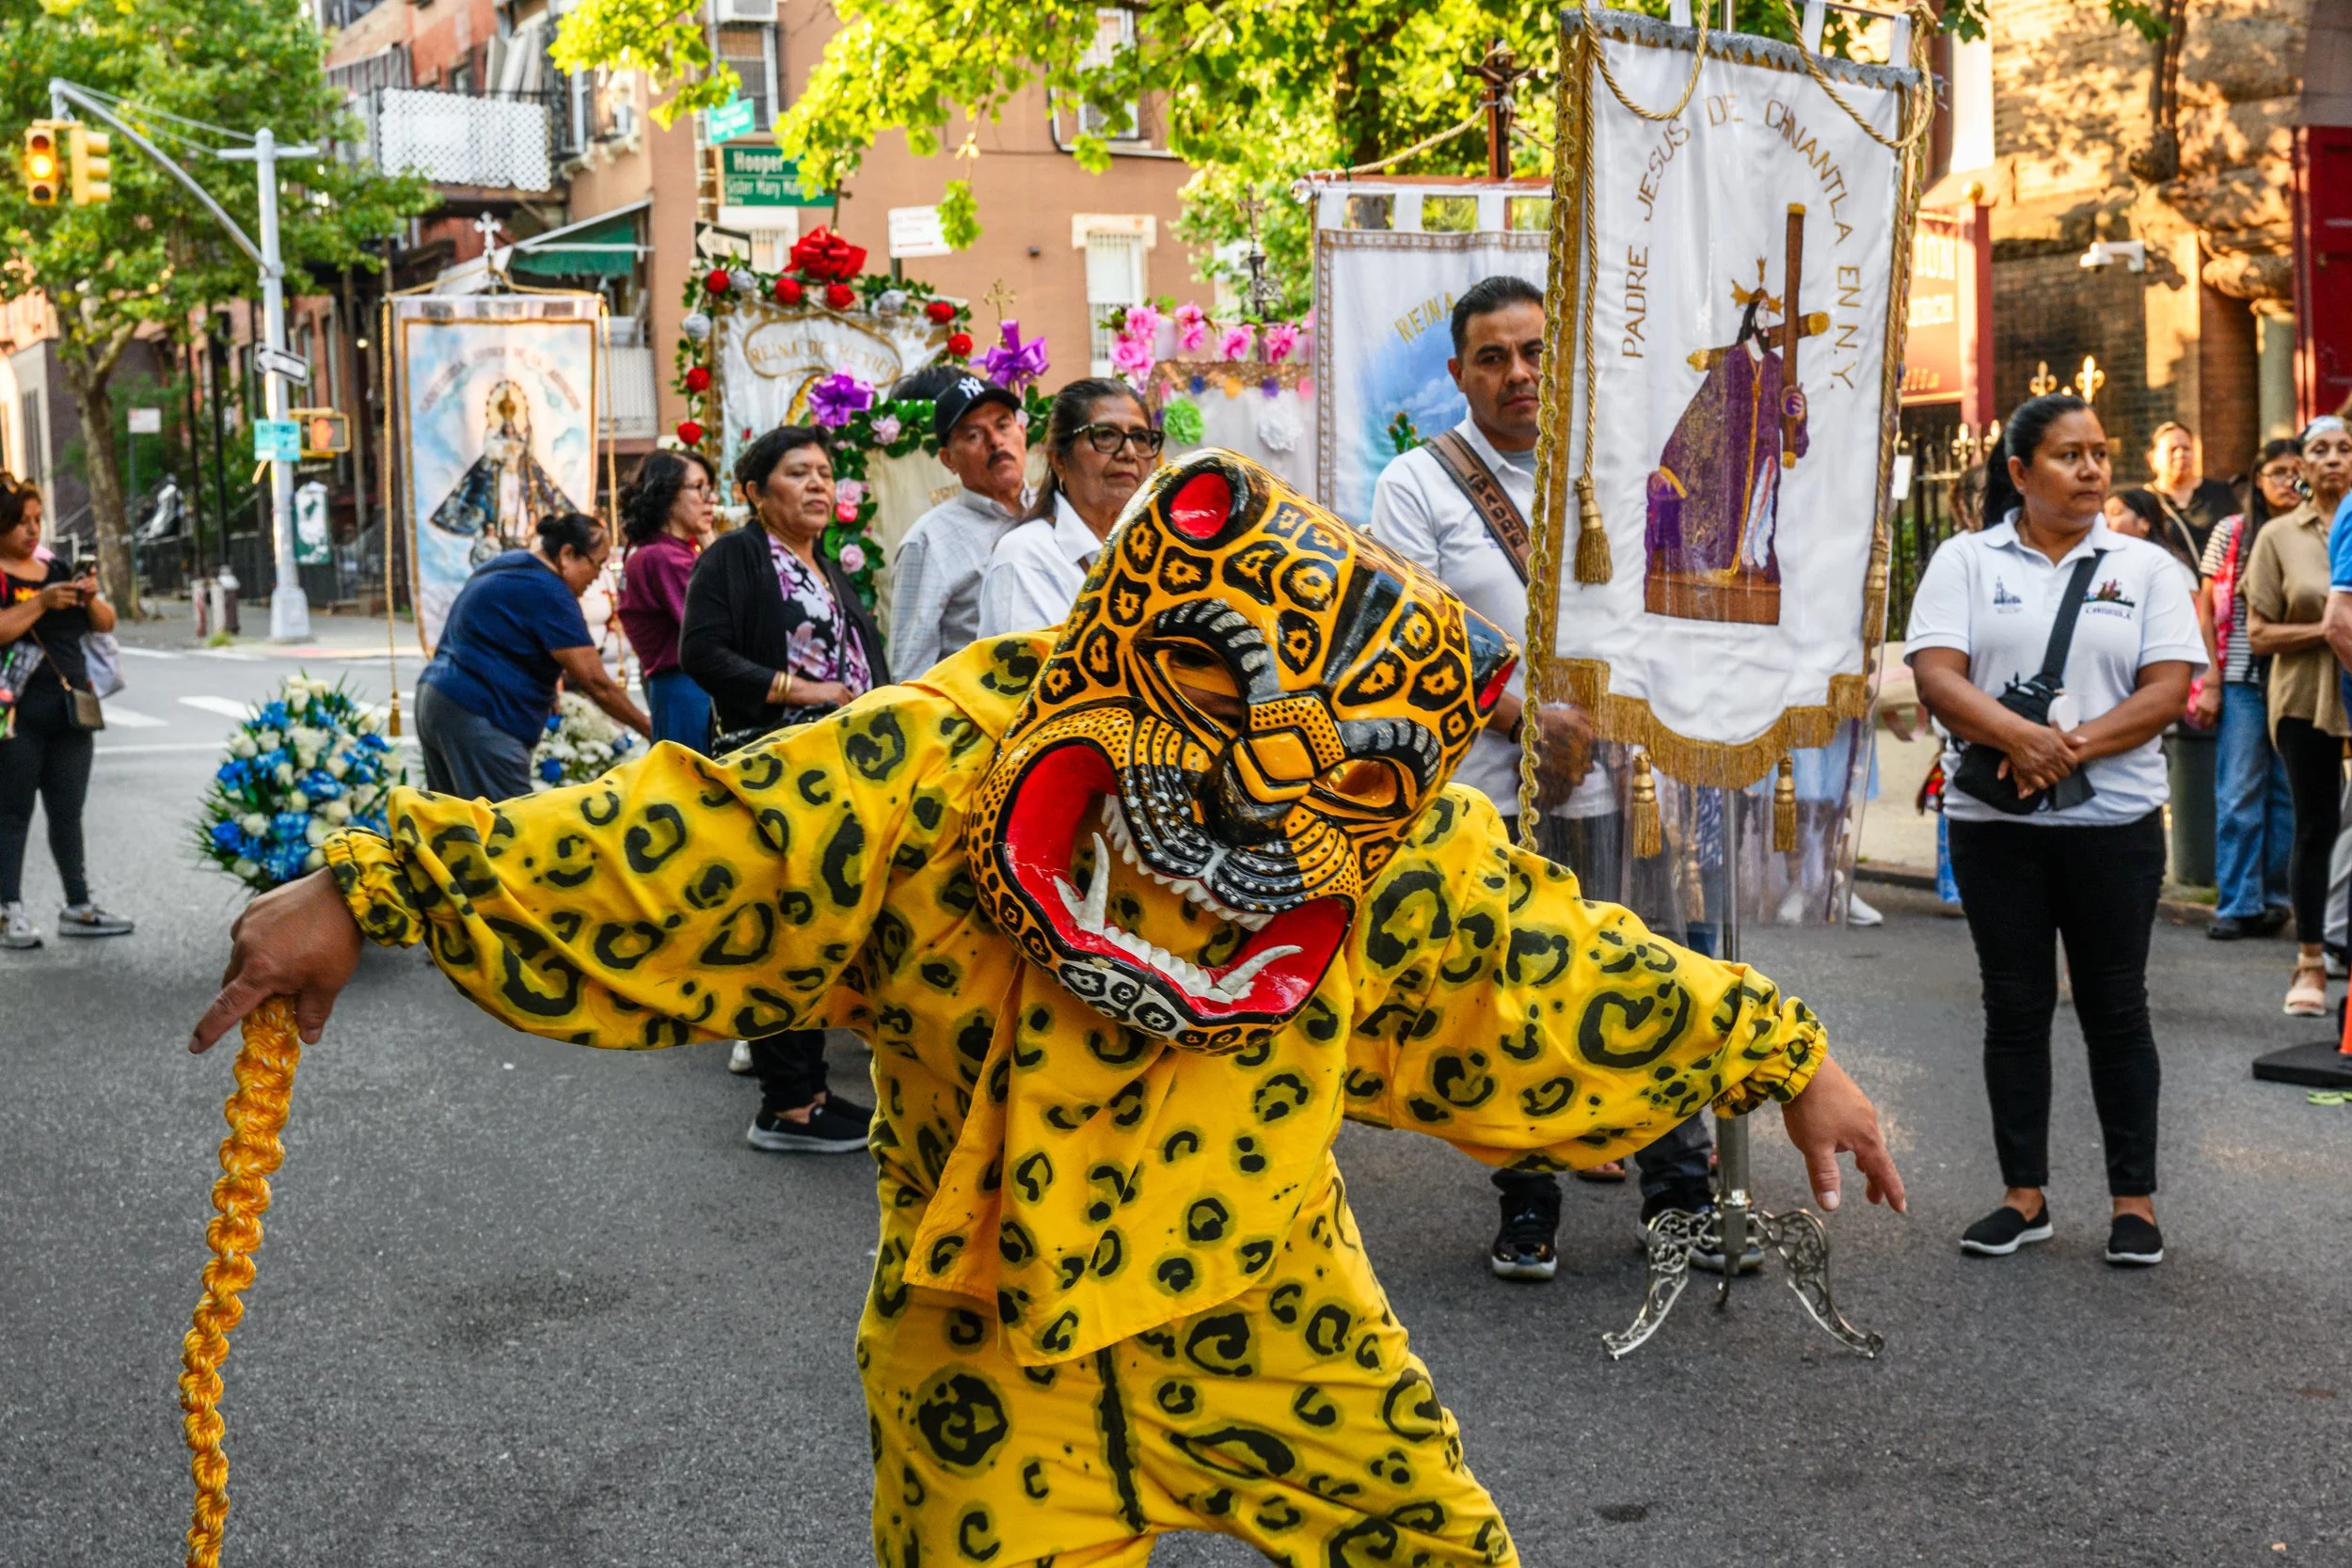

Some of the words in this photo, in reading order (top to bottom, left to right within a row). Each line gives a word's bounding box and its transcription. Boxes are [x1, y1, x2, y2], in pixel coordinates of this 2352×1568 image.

[734, 150, 783, 176] Hooper
[755, 180, 782, 199] Mary
[1622, 245, 1648, 359] PADRE
[1637, 116, 1691, 222] JESUS
[1702, 92, 1744, 128] DE
[1837, 265, 1861, 308] EN
[1394, 292, 1454, 345] REINA
[958, 376, 985, 399] NY
